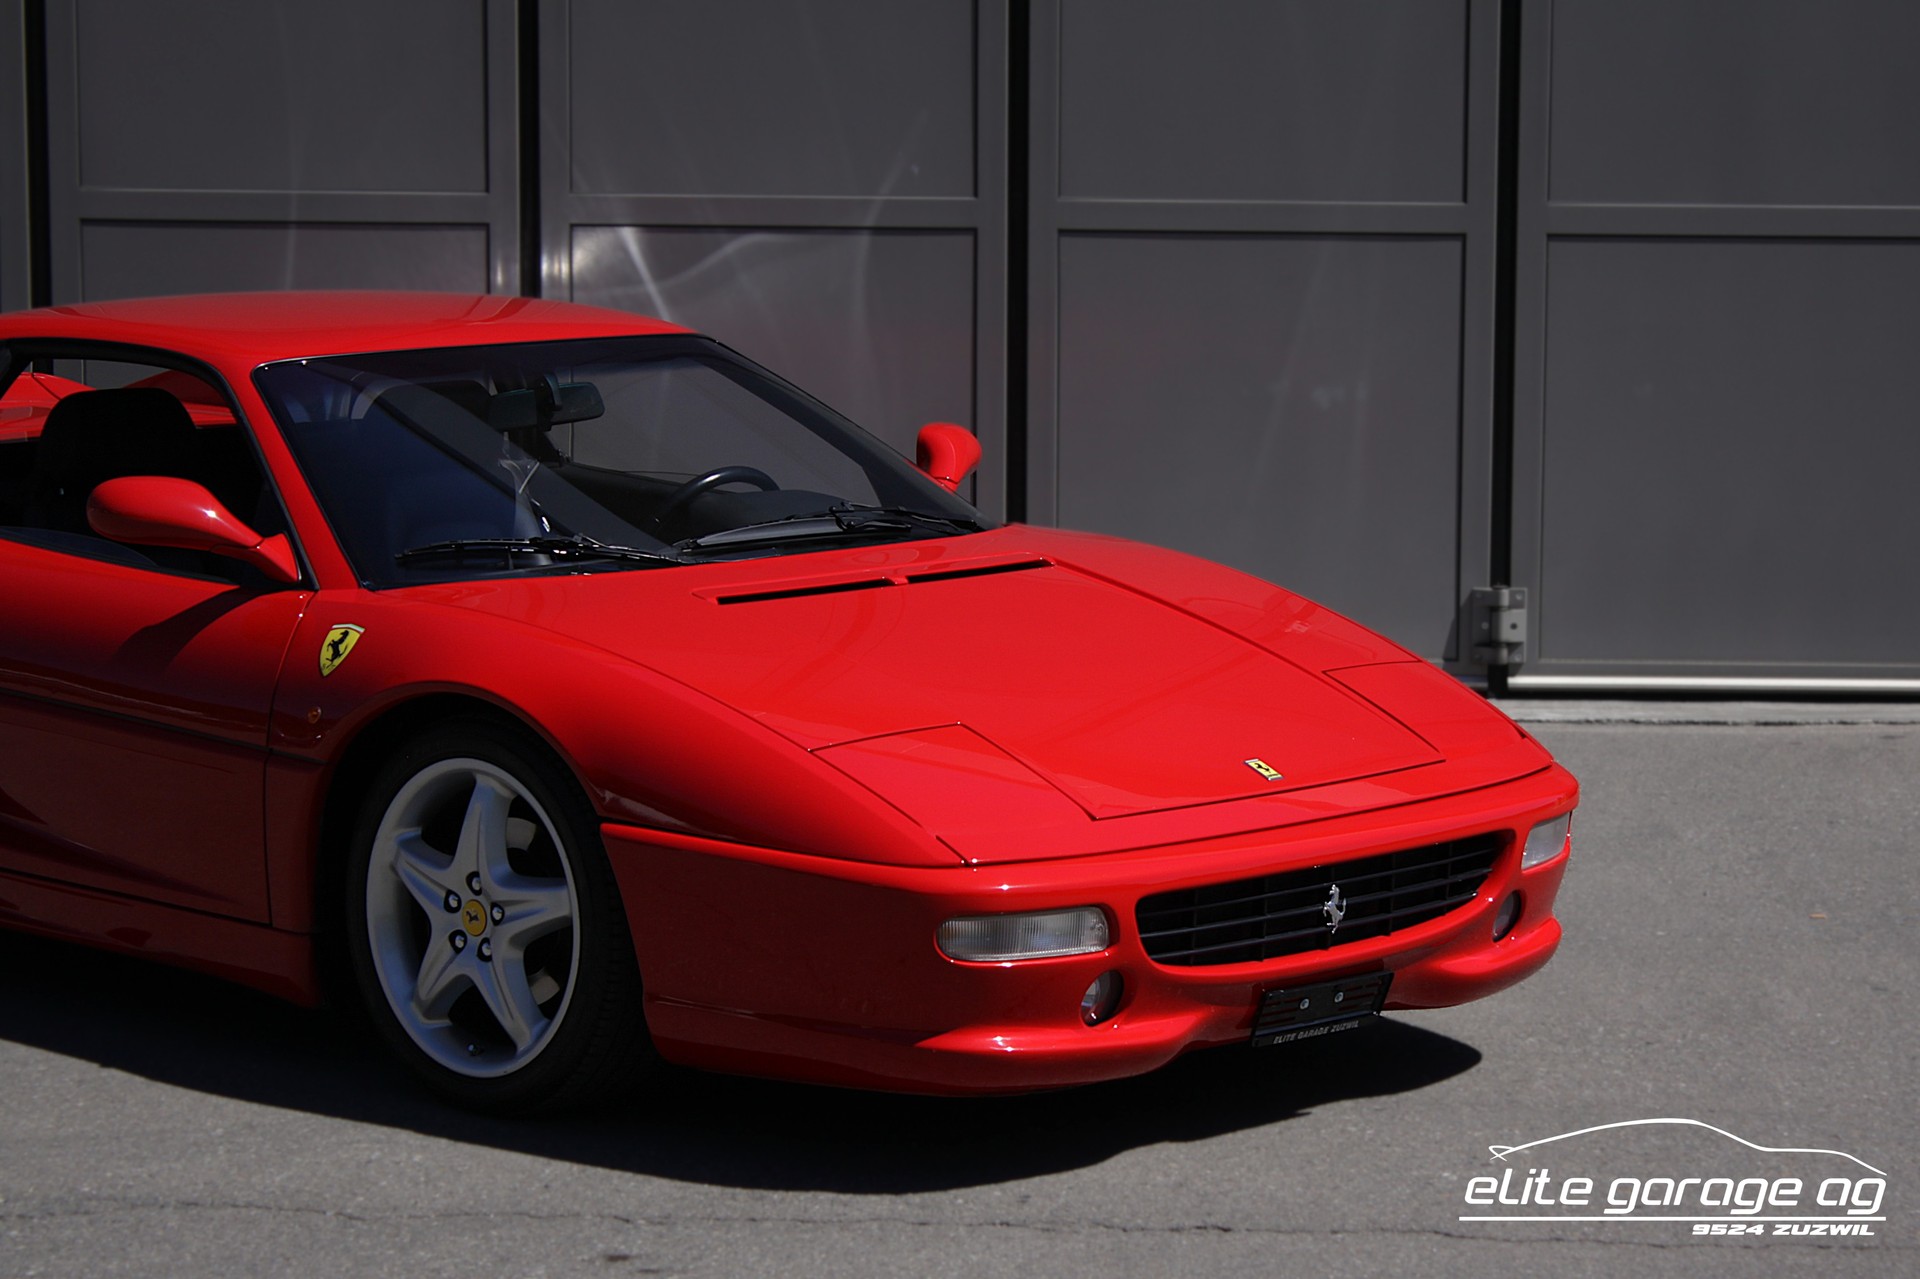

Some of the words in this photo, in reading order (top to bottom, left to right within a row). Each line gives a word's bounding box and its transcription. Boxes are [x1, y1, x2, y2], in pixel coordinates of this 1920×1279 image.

[1273, 1032, 1297, 1044] ELITE
[1297, 1026, 1330, 1040] GARAGE
[1330, 1020, 1359, 1032] ZUZWIL
